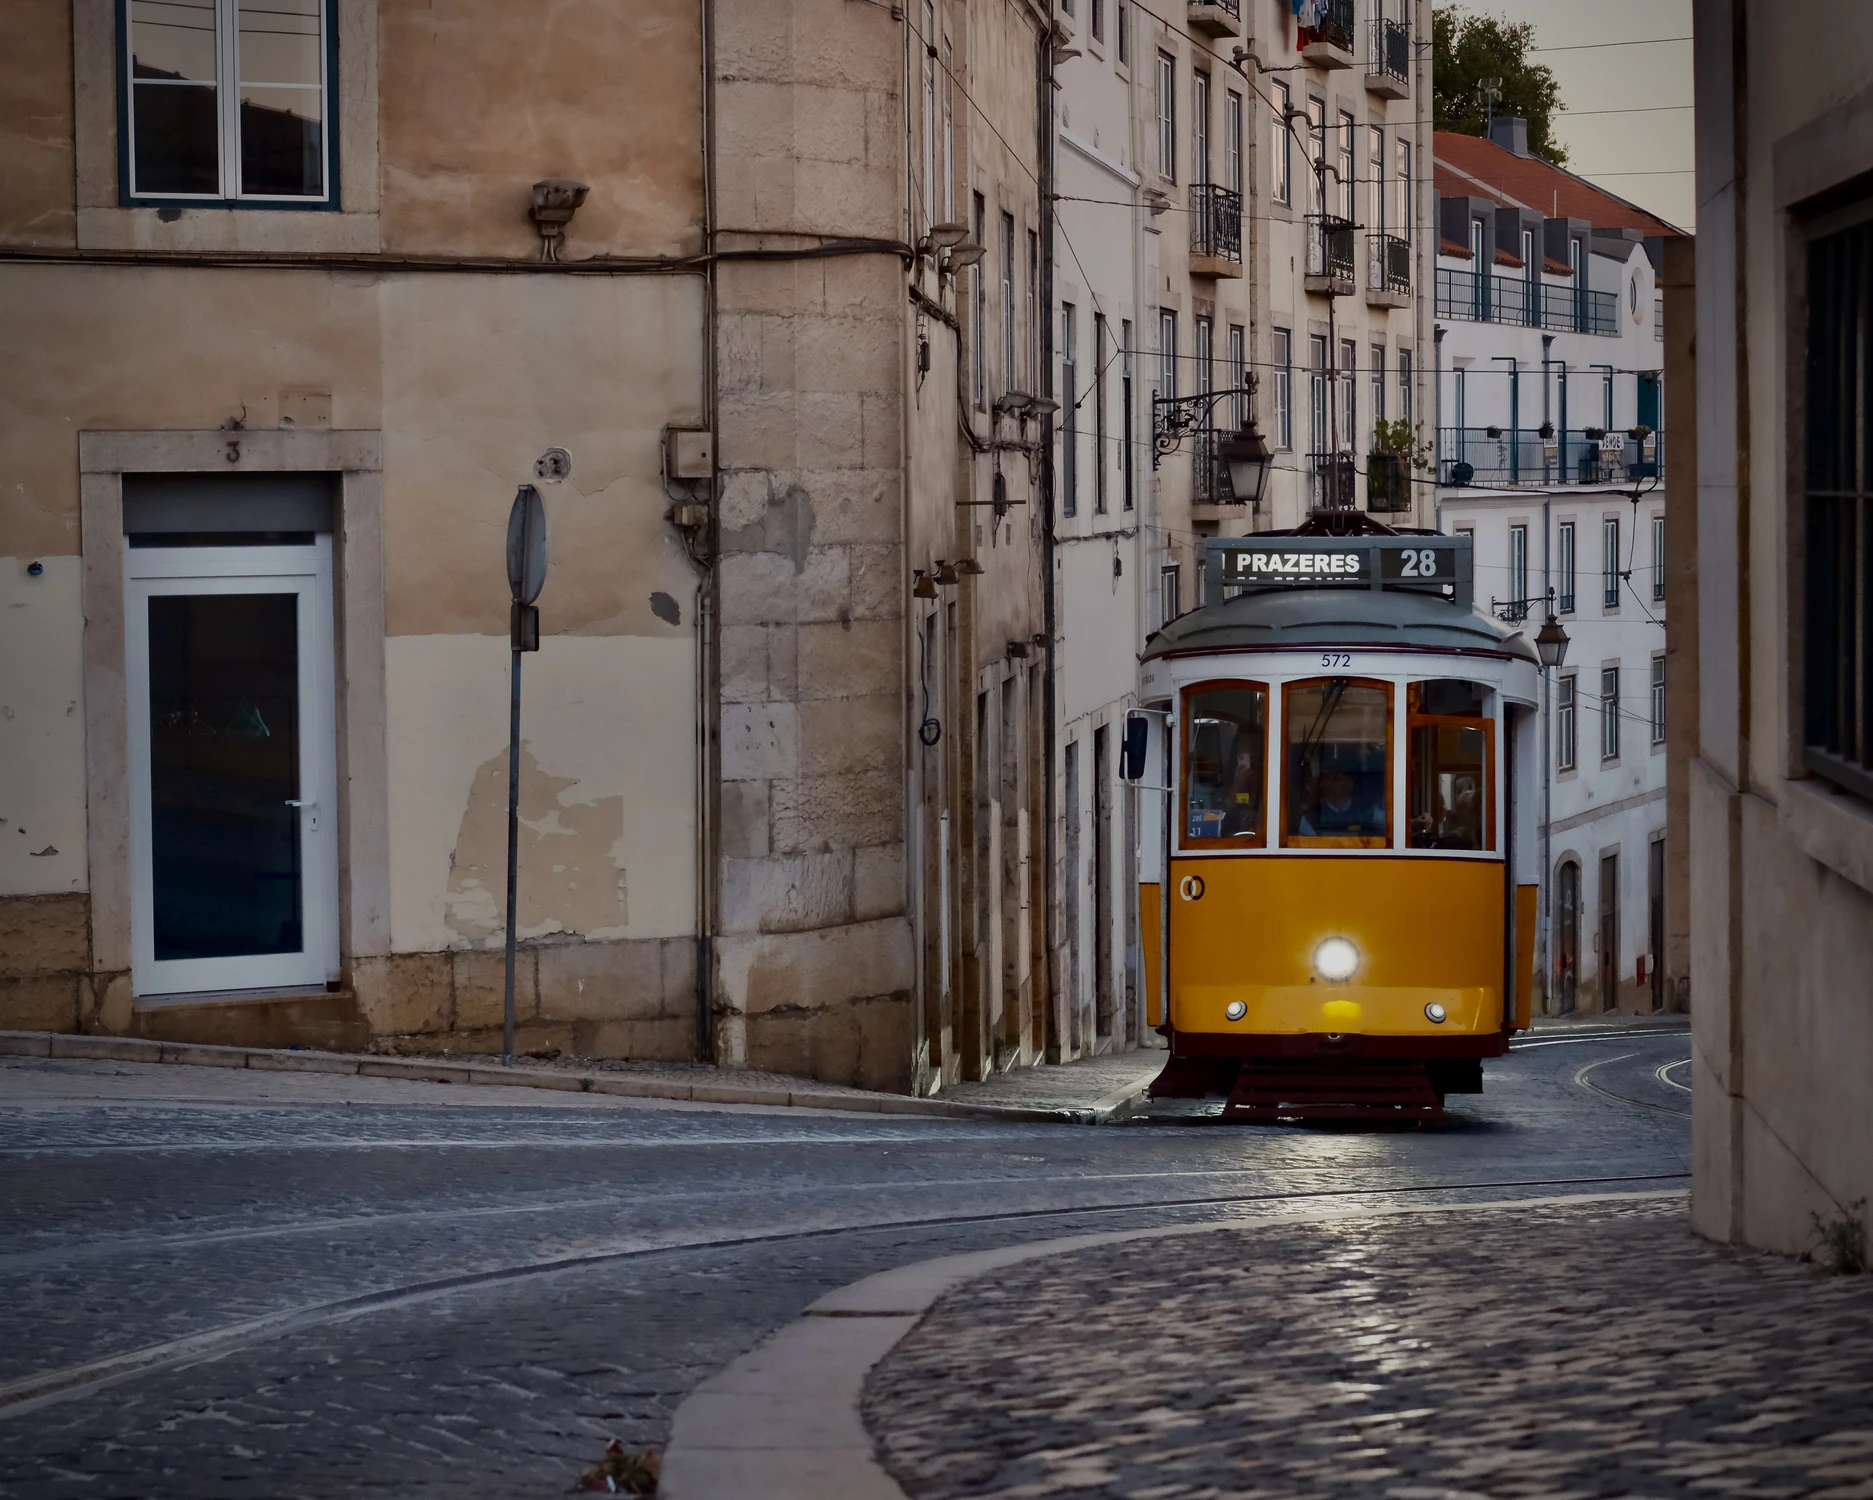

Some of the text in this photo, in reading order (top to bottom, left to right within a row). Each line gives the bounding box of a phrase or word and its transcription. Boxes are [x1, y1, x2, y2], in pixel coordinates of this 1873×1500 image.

[226, 440, 241, 463] 3
[1237, 553, 1360, 573] PRAZERES
[1400, 549, 1437, 577] 28
[1321, 654, 1350, 668] 572
